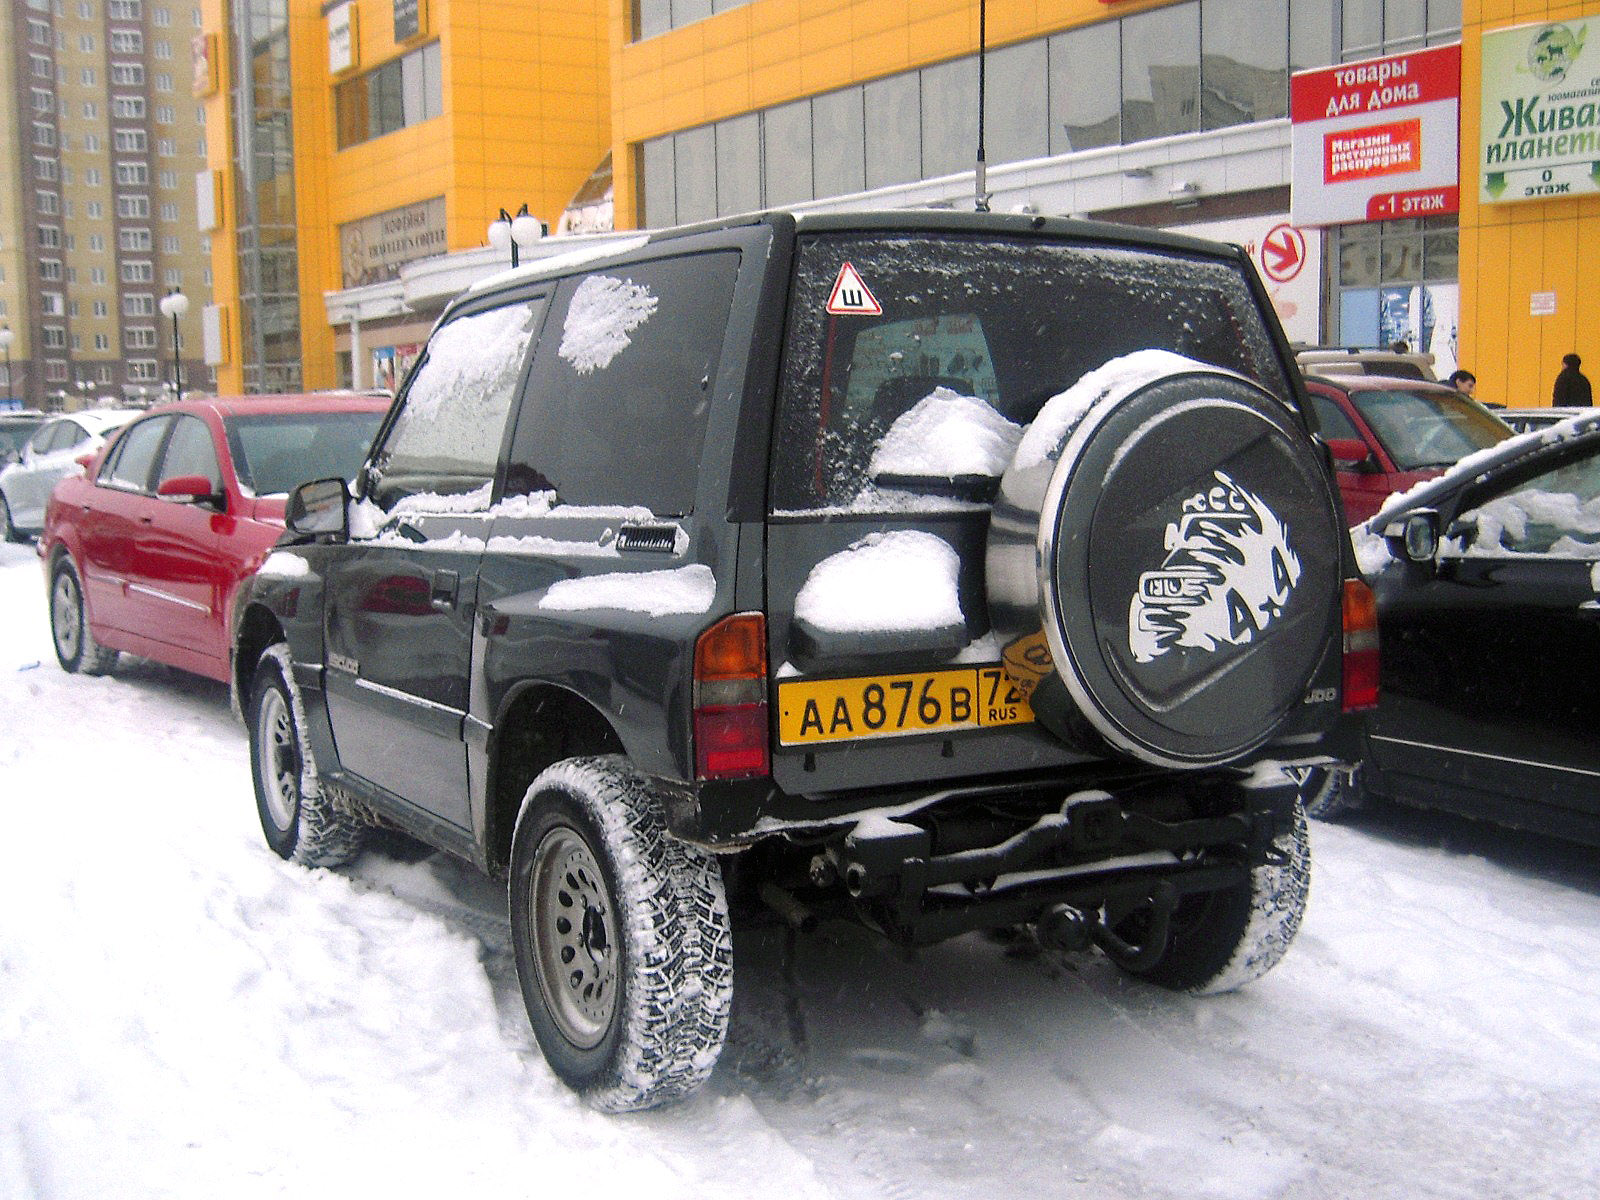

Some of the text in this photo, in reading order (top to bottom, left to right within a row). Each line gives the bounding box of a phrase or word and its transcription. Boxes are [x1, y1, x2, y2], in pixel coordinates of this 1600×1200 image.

[1334, 60, 1407, 88] товары
[1326, 82, 1419, 117] для дома
[1498, 95, 1600, 139] Жива
[1332, 134, 1390, 153] Магазин
[1332, 142, 1410, 163] постоянных
[1487, 131, 1600, 164] планет
[1332, 152, 1411, 176] распродаж
[1525, 183, 1570, 196] этаж
[1402, 194, 1444, 213] этаж
[842, 289, 863, 306] Ш
[988, 707, 1017, 722] RUS
